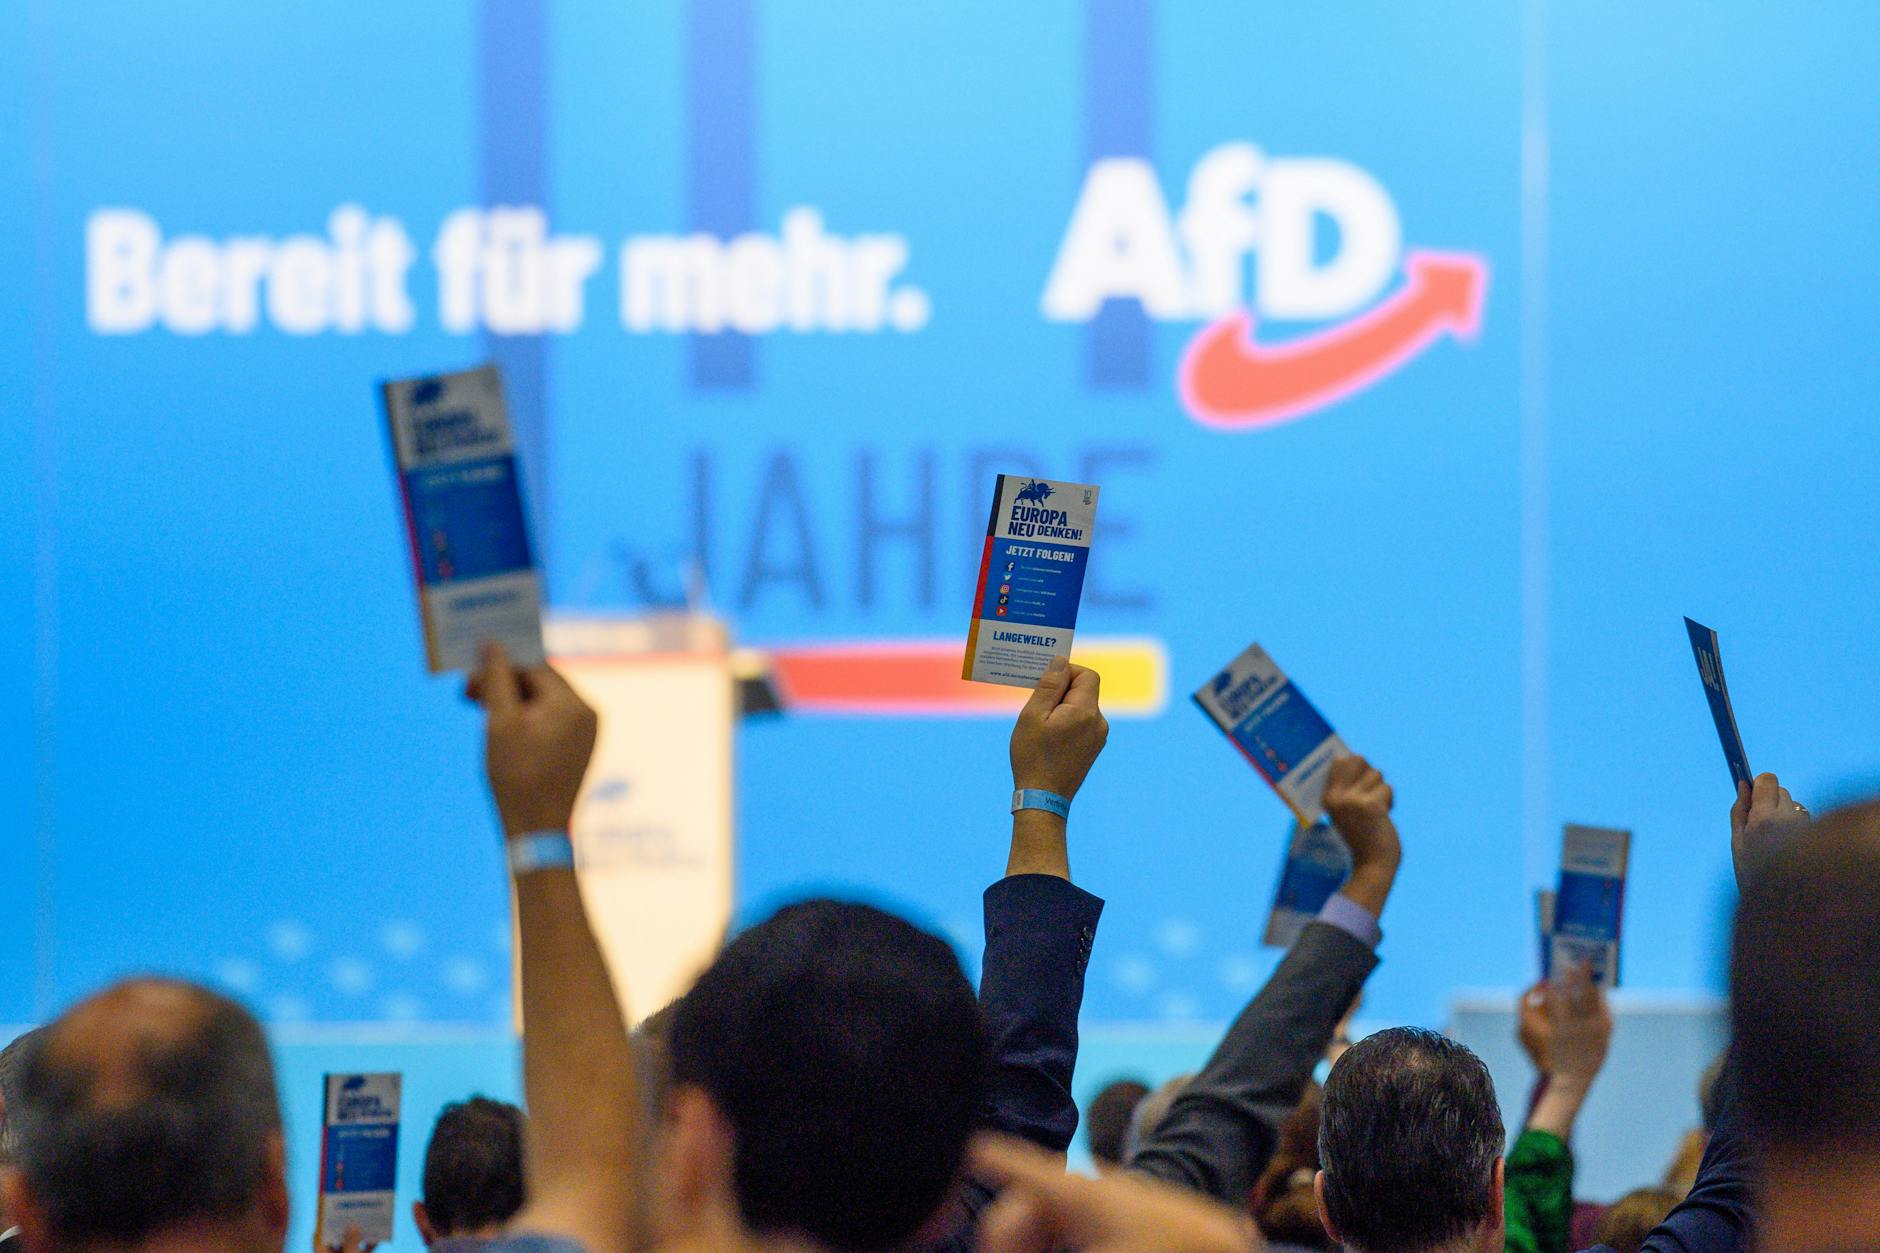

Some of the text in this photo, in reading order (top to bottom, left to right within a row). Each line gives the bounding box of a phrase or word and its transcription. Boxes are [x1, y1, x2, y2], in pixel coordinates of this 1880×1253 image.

[1041, 142, 1402, 322] AfD
[86, 206, 931, 335] Bereit für mehr.
[1011, 505, 1068, 527] EUROPA
[1008, 521, 1083, 540] NEU DENKEN!
[1006, 545, 1075, 562] JETZT FOLGEN!
[993, 630, 1057, 647] LANGEWEILE?
